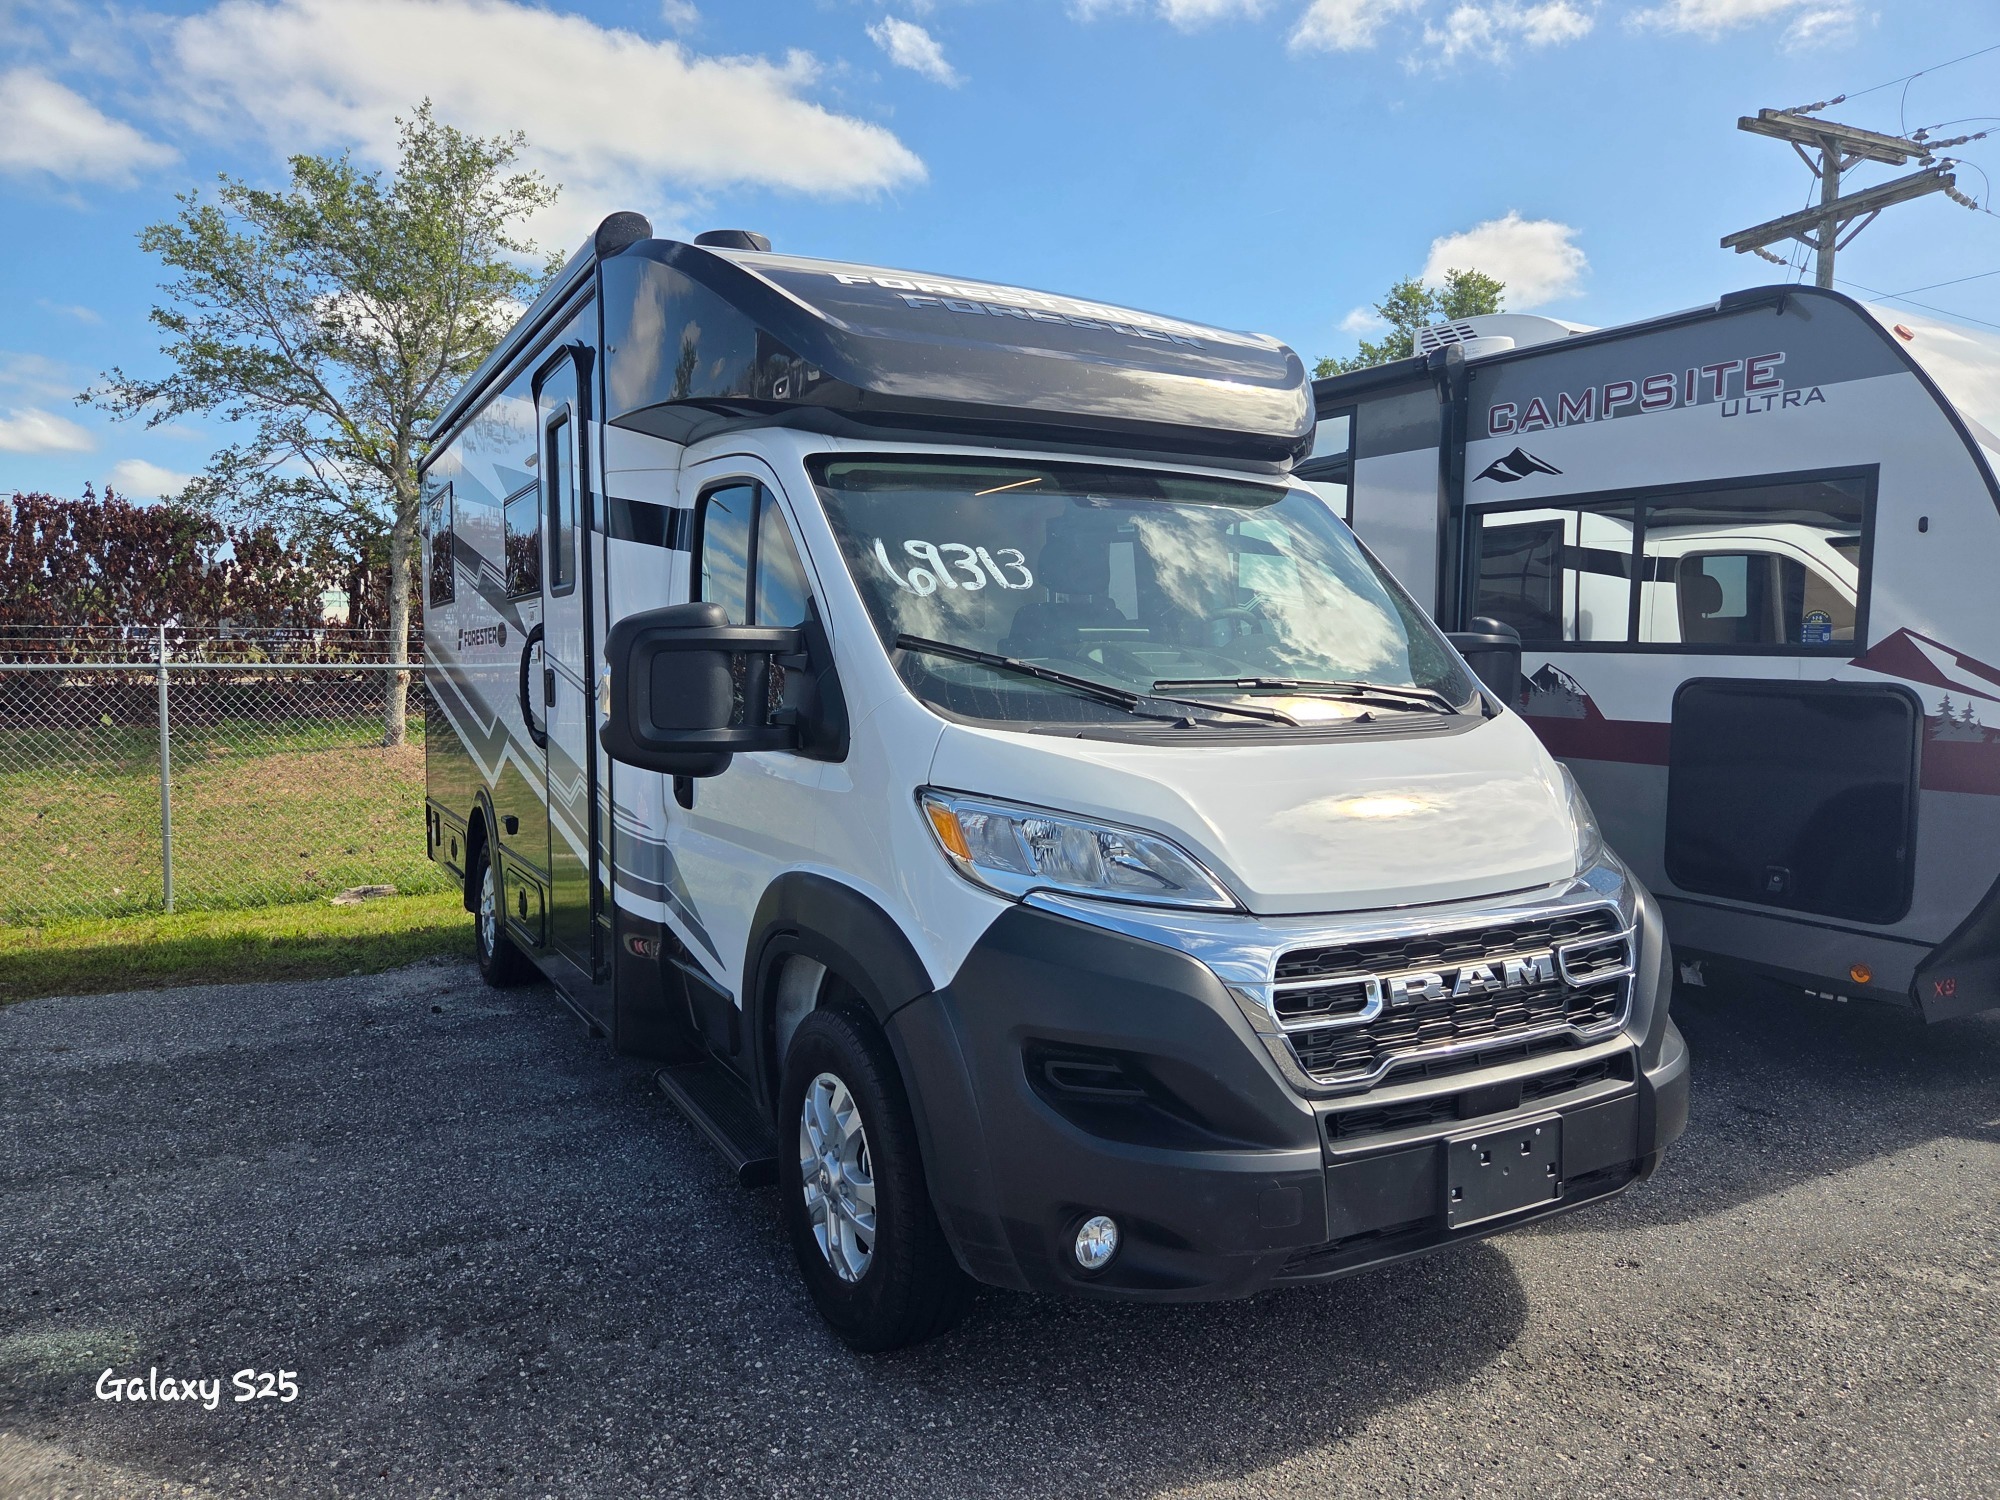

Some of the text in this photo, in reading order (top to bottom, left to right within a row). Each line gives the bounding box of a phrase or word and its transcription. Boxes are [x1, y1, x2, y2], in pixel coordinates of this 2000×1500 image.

[828, 272, 1219, 339] FOREST RIVER
[896, 293, 1207, 350] FORESTER
[1488, 351, 1786, 437] CAMPSITE
[1721, 386, 1826, 418] ULTRA
[873, 537, 1034, 597] 69313
[464, 626, 497, 647] FORESTER
[1387, 953, 1554, 1007] RAM
